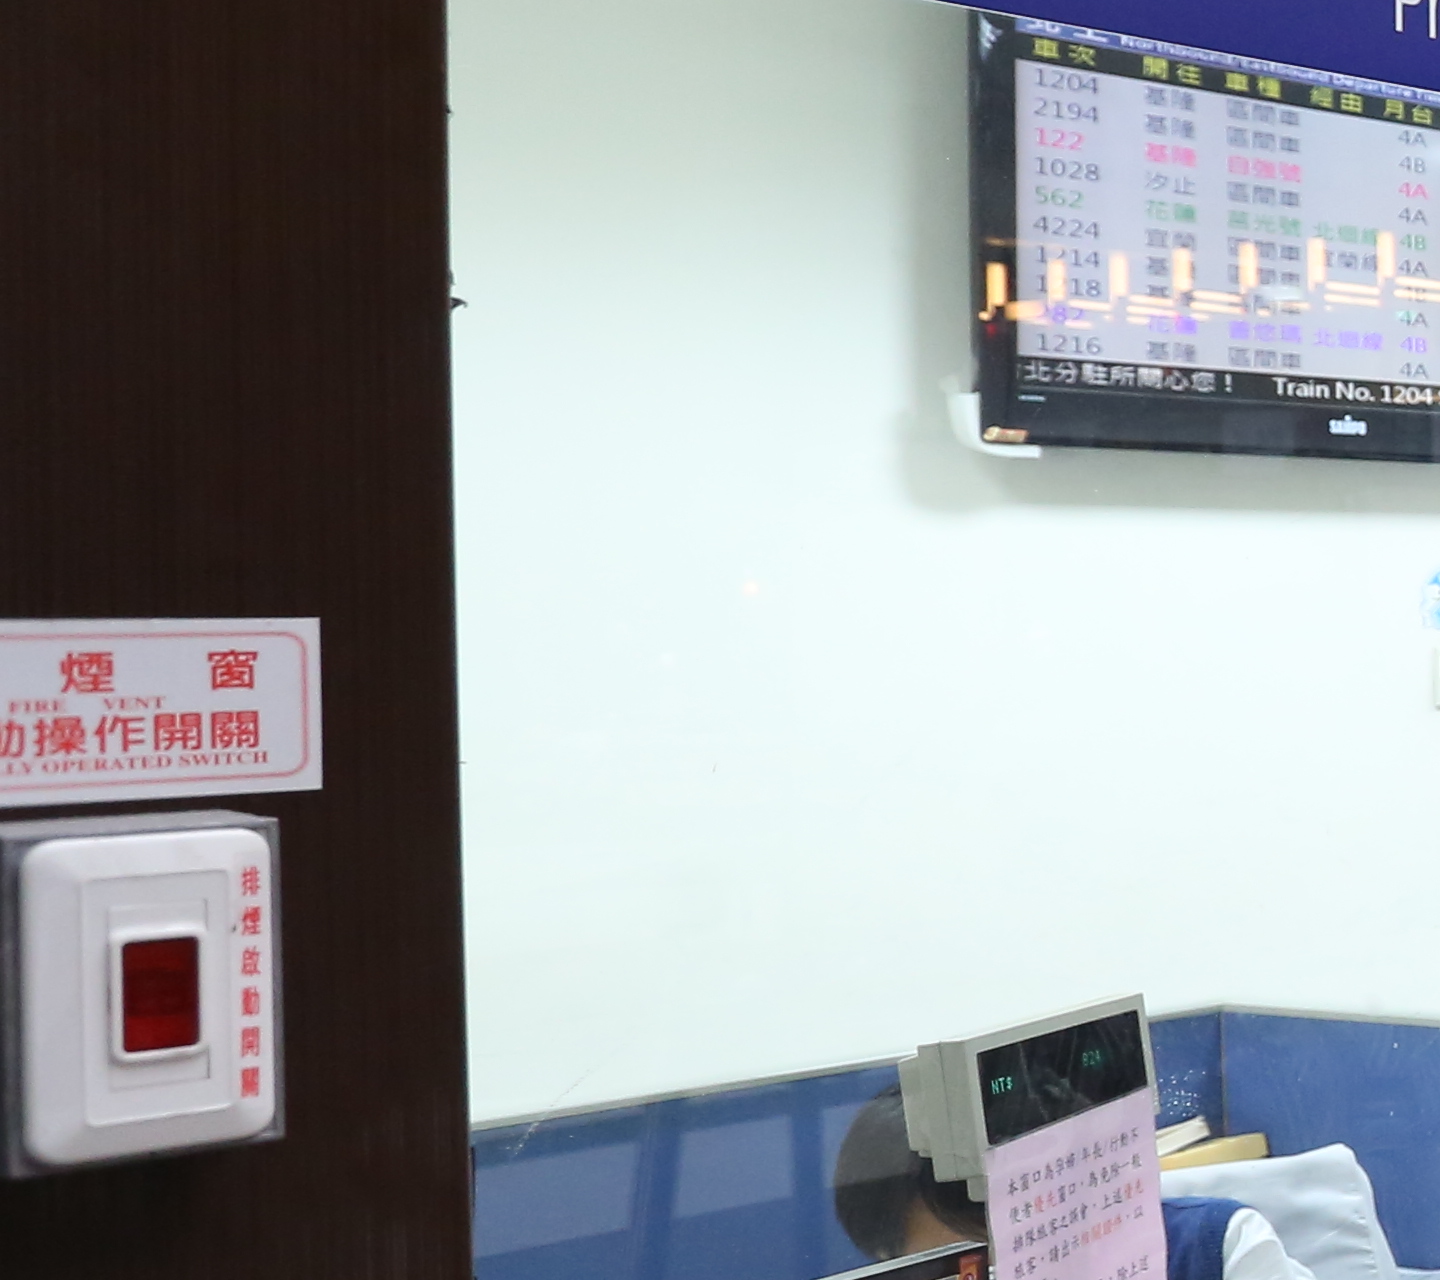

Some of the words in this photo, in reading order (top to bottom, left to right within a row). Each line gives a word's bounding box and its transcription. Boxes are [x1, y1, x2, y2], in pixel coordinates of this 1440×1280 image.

[1034, 97, 1099, 123] 2194
[1399, 155, 1426, 174] 4B
[1035, 67, 1099, 95] 1204
[1399, 130, 1428, 149] 4A
[1034, 126, 1086, 151] 122
[1398, 181, 1429, 201] 4A
[1035, 155, 1100, 182] 1028
[1146, 170, 1197, 196] 汐止
[1399, 206, 1429, 225] 4A
[1033, 215, 1100, 240] 4224
[1399, 259, 1429, 278] 4A
[1034, 185, 1085, 210] 562
[1400, 234, 1427, 252] 4B
[1399, 309, 1429, 329] 4A
[1400, 336, 1428, 355] 4B
[1036, 331, 1102, 357] 1216
[1399, 362, 1429, 380] 4A
[1272, 376, 1332, 400] Train
[1335, 380, 1376, 403] No.
[1380, 384, 1434, 408] 1204
[9, 698, 67, 714] FIRE
[103, 695, 167, 711] VENT
[41, 755, 173, 775] OPERATED
[178, 749, 269, 769] SWITCH
